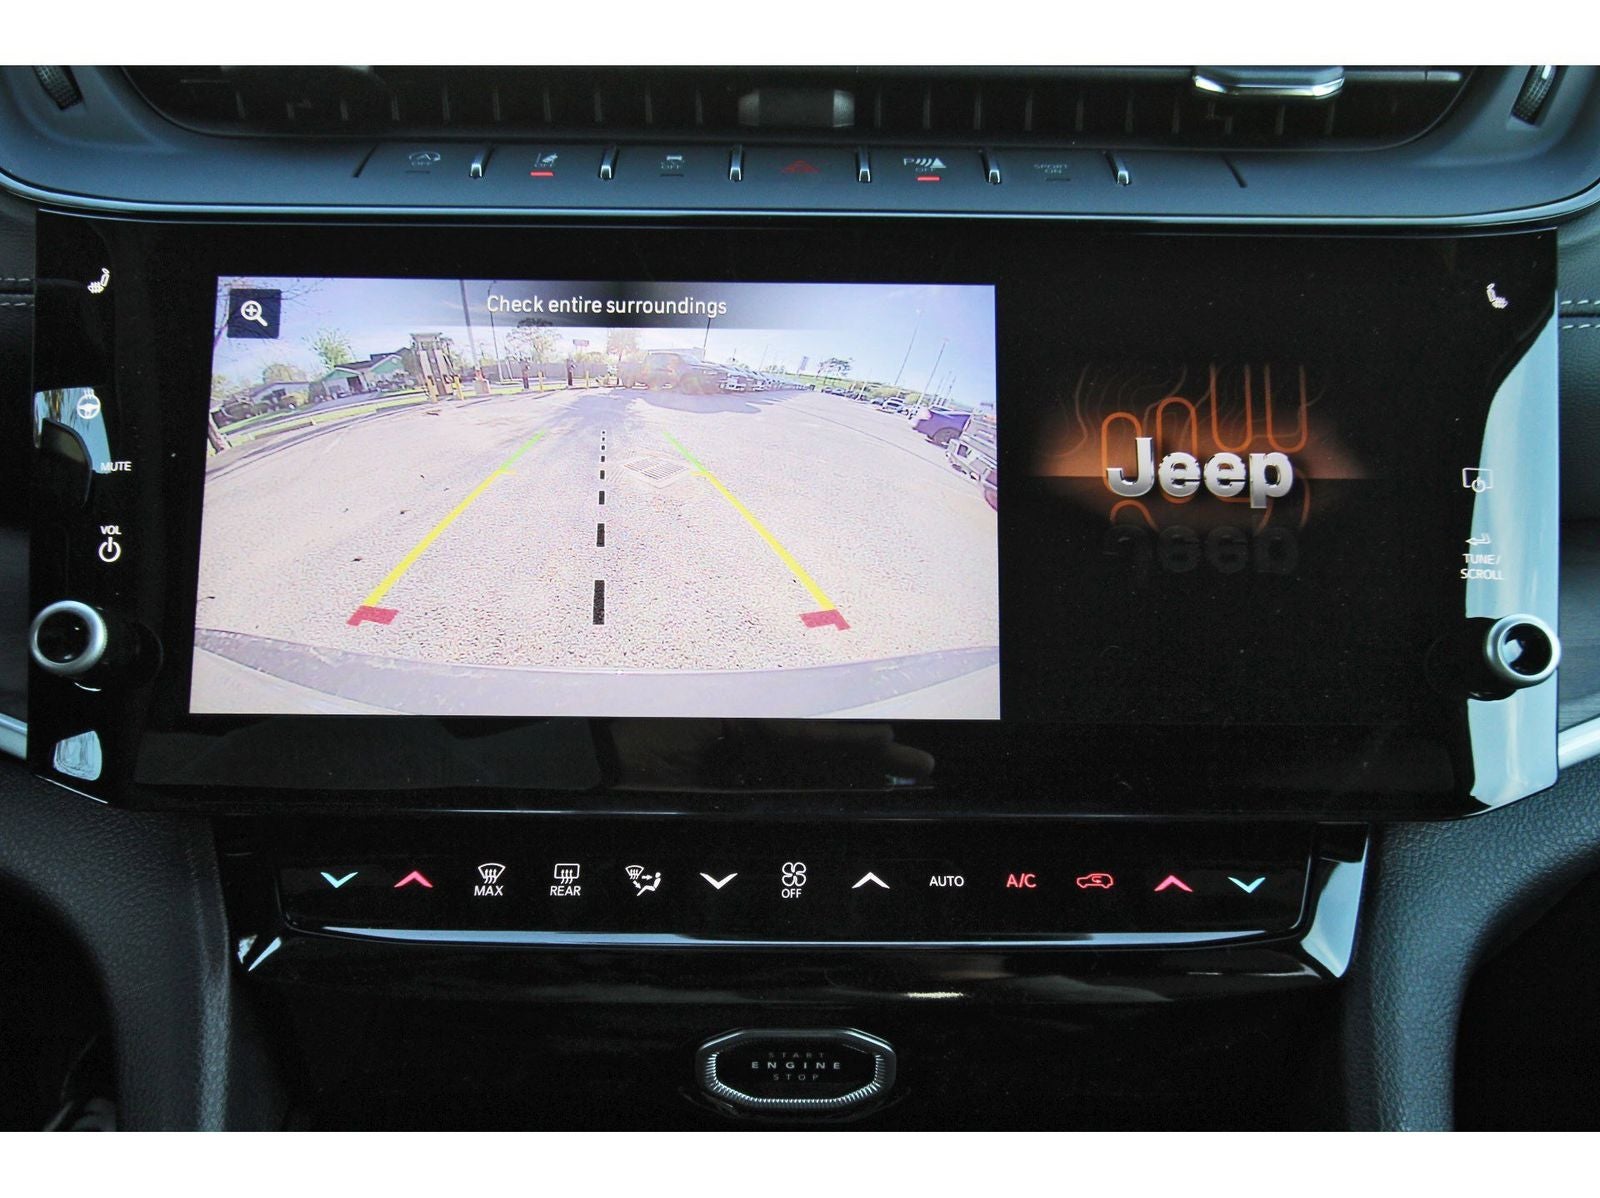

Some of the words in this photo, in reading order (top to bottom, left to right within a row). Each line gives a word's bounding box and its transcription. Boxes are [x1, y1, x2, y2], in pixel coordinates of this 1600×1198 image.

[486, 295, 544, 313] Check
[549, 296, 602, 314] entire
[606, 297, 727, 318] surroundings
[101, 461, 132, 472] MUTE
[1106, 437, 1293, 509] Jeep
[100, 525, 122, 535] VOL
[1460, 568, 1504, 580] SCROLL
[929, 875, 965, 888] AUTO
[1006, 873, 1037, 888] A/C
[474, 885, 504, 896] MAX
[549, 885, 581, 896] REAR
[781, 888, 802, 899] OFF
[751, 1061, 841, 1070] ENGINE
